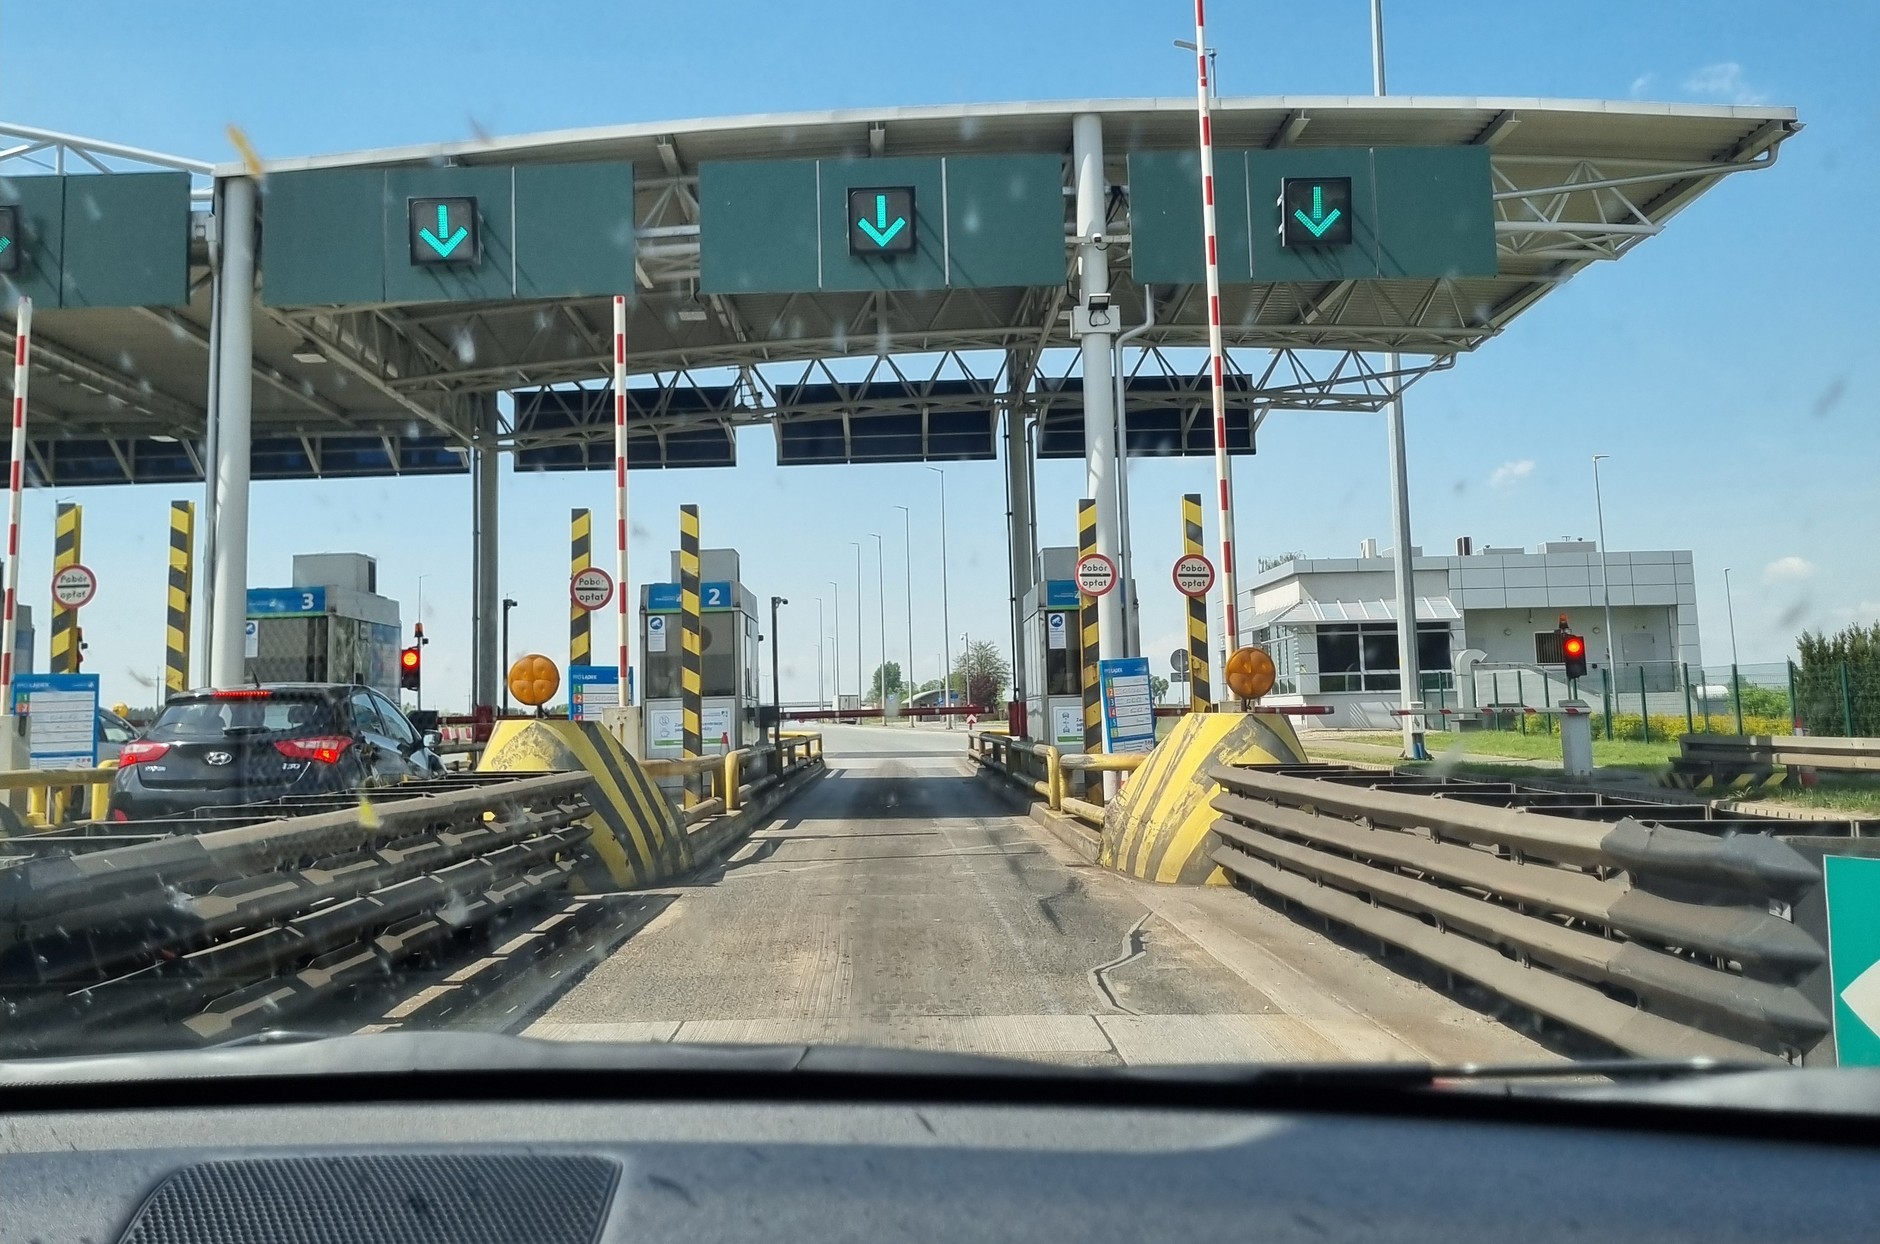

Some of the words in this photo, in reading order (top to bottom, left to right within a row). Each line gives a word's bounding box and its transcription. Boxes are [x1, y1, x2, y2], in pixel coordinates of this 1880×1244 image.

[1082, 563, 1107, 572] Pobór
[1181, 563, 1206, 572] Pobór
[60, 574, 88, 583] Pobór
[1083, 580, 1107, 588] opłat
[1181, 579, 1206, 588] opłat
[60, 589, 87, 600] opłat
[579, 593, 604, 602] opłat
[708, 588, 720, 605] 2
[301, 593, 314, 610] 3
